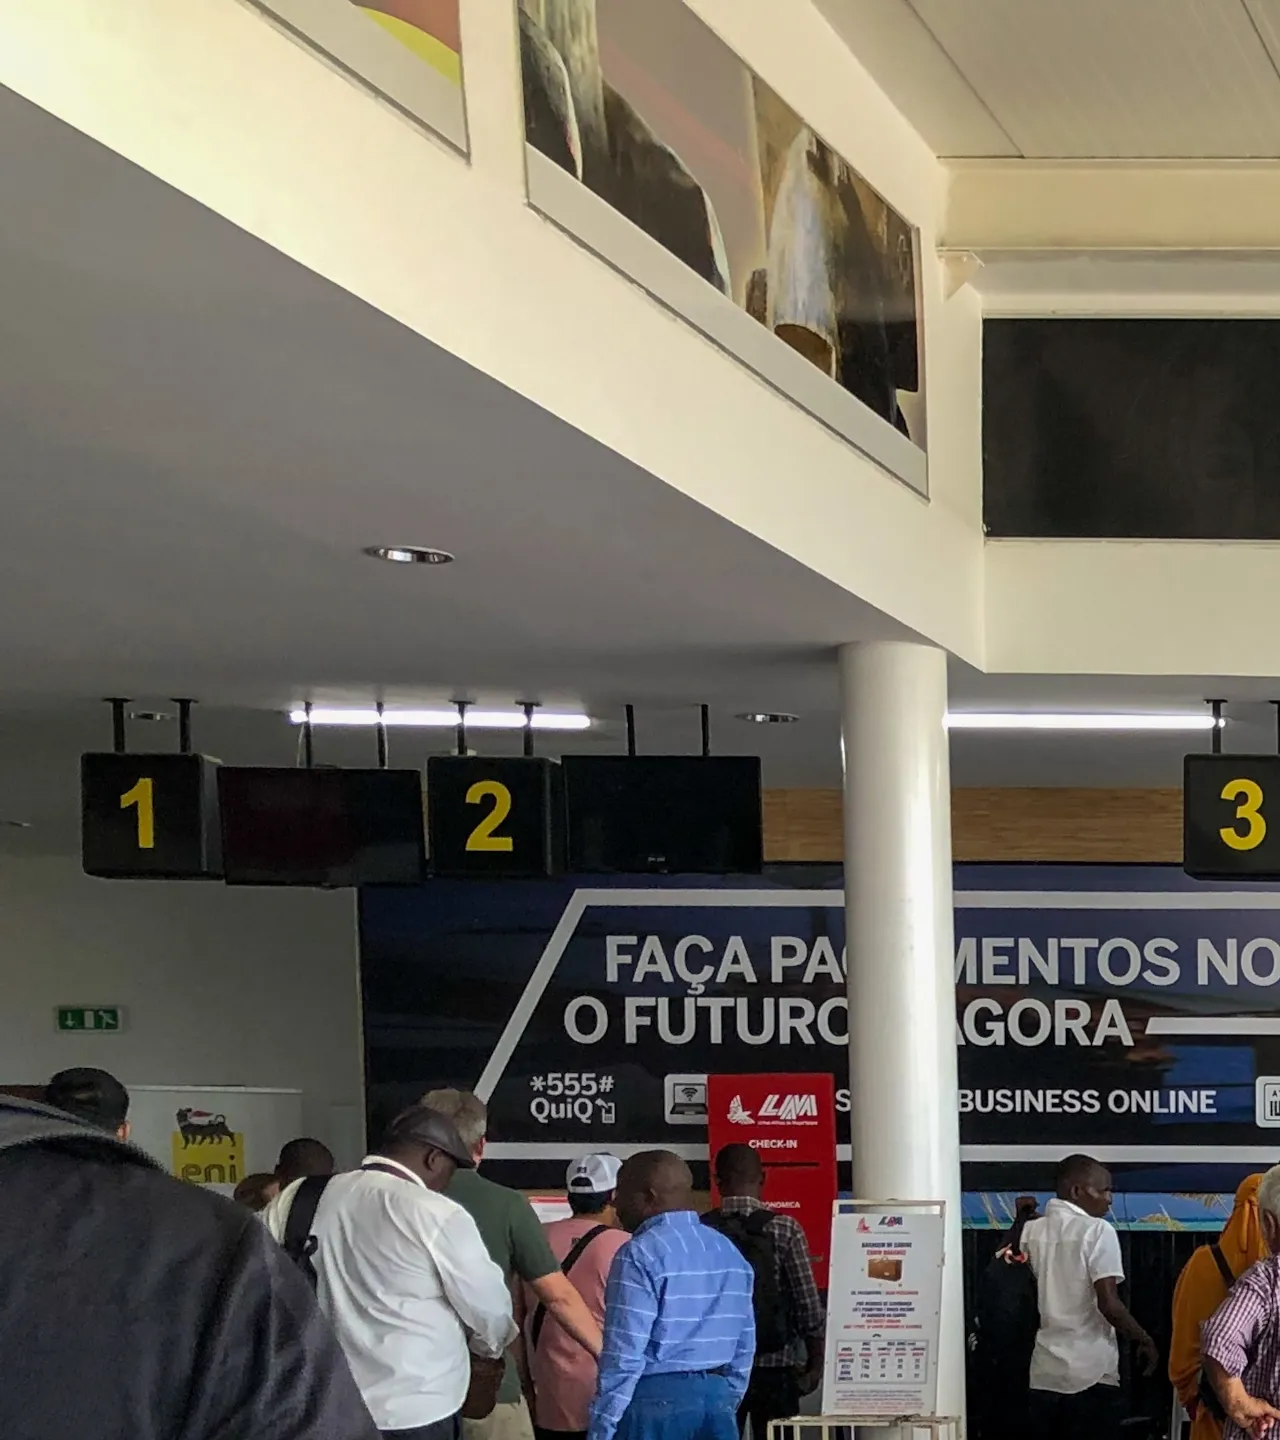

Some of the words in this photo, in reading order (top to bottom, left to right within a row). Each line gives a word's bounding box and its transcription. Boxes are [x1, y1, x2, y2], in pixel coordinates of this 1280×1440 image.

[120, 778, 154, 848] 1
[465, 781, 513, 852] 2
[1220, 779, 1267, 851] 3
[606, 935, 757, 994] FAÇA
[564, 995, 609, 1045] O
[957, 998, 1135, 1047] GORA
[530, 1098, 594, 1124] QuiQ
[758, 1094, 818, 1120] LAM
[958, 1089, 1100, 1113] BUSINESS
[1108, 1089, 1217, 1114] ONLINE
[748, 1139, 797, 1149] CHECK-IN
[181, 1154, 236, 1184] eni
